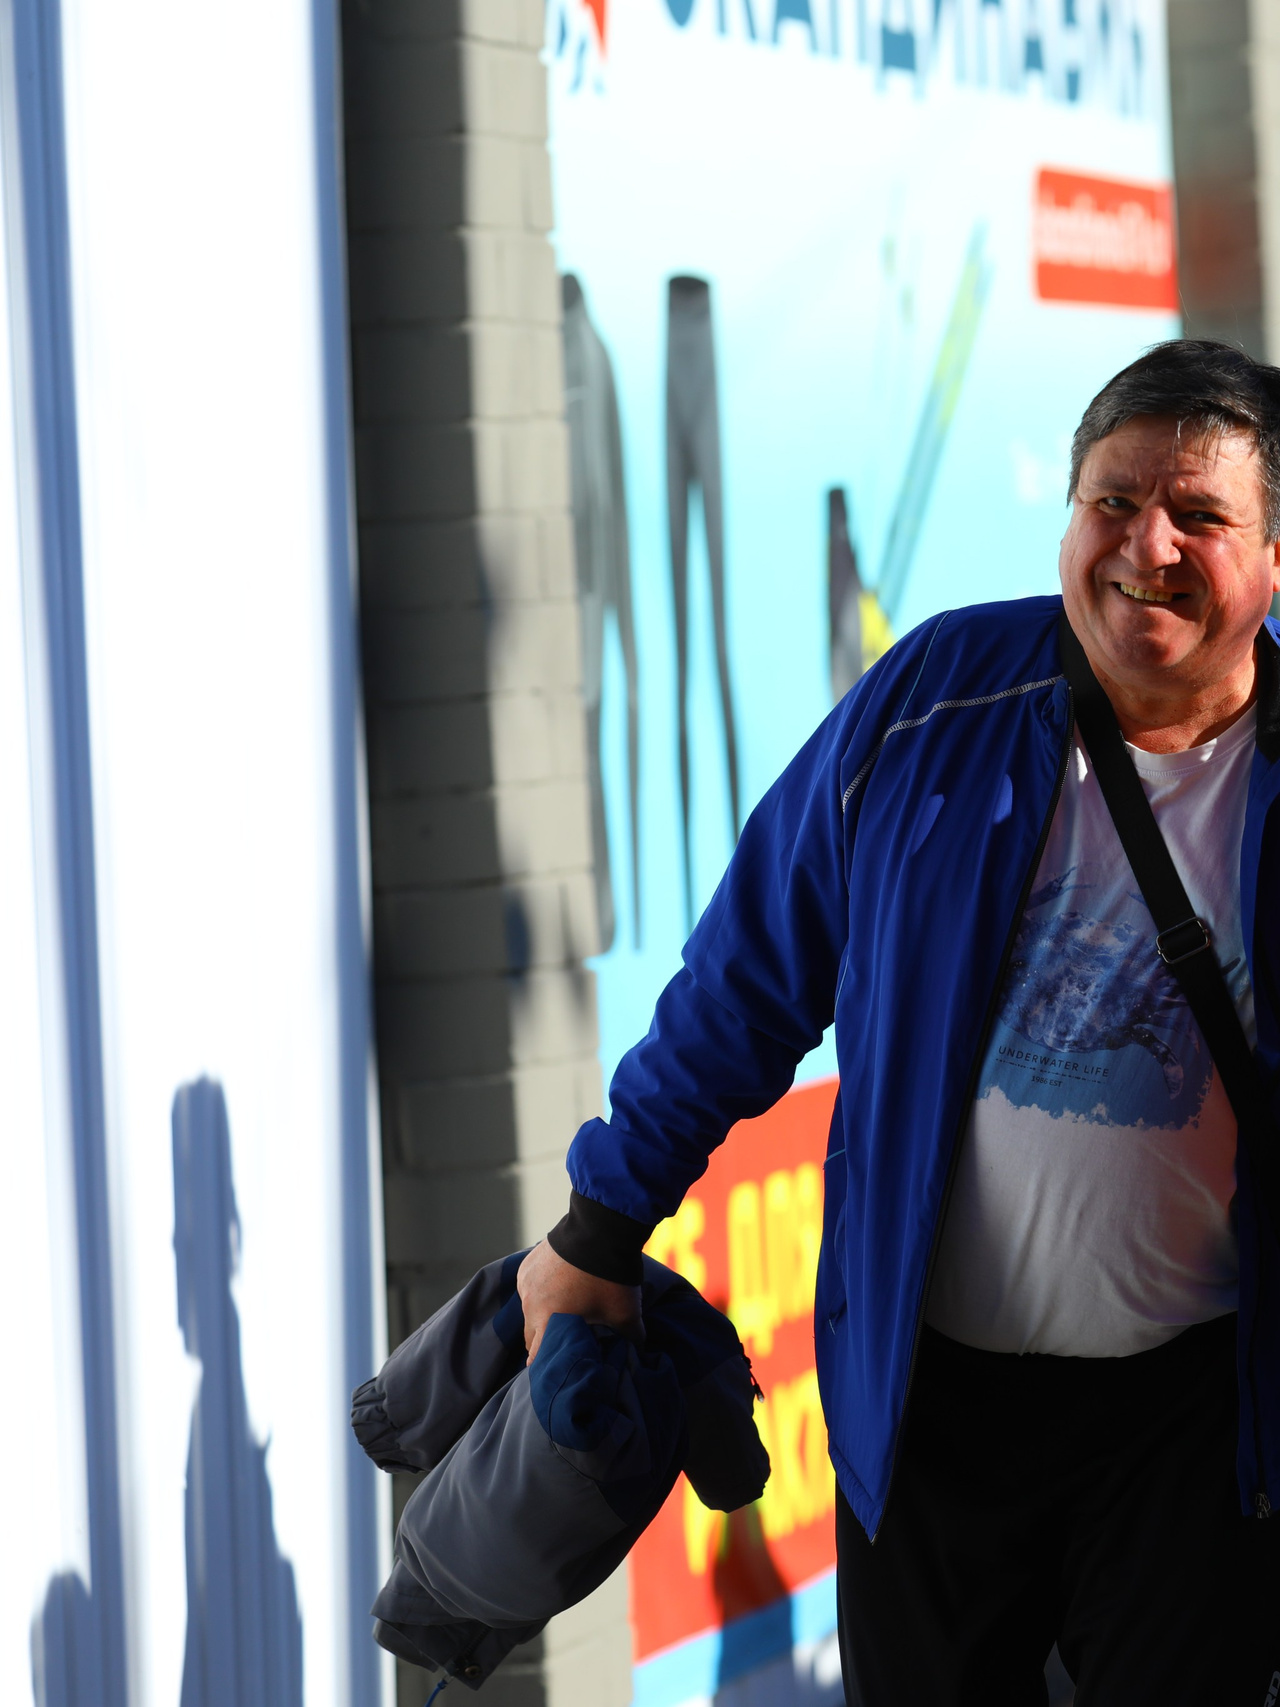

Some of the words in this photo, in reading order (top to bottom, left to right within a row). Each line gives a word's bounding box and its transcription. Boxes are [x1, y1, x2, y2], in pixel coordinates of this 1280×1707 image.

[998, 1045, 1079, 1072] UNDERWATER
[1083, 1065, 1110, 1078] LIFE
[1031, 1075, 1048, 1085] 1986
[1049, 1079, 1063, 1088] EST
